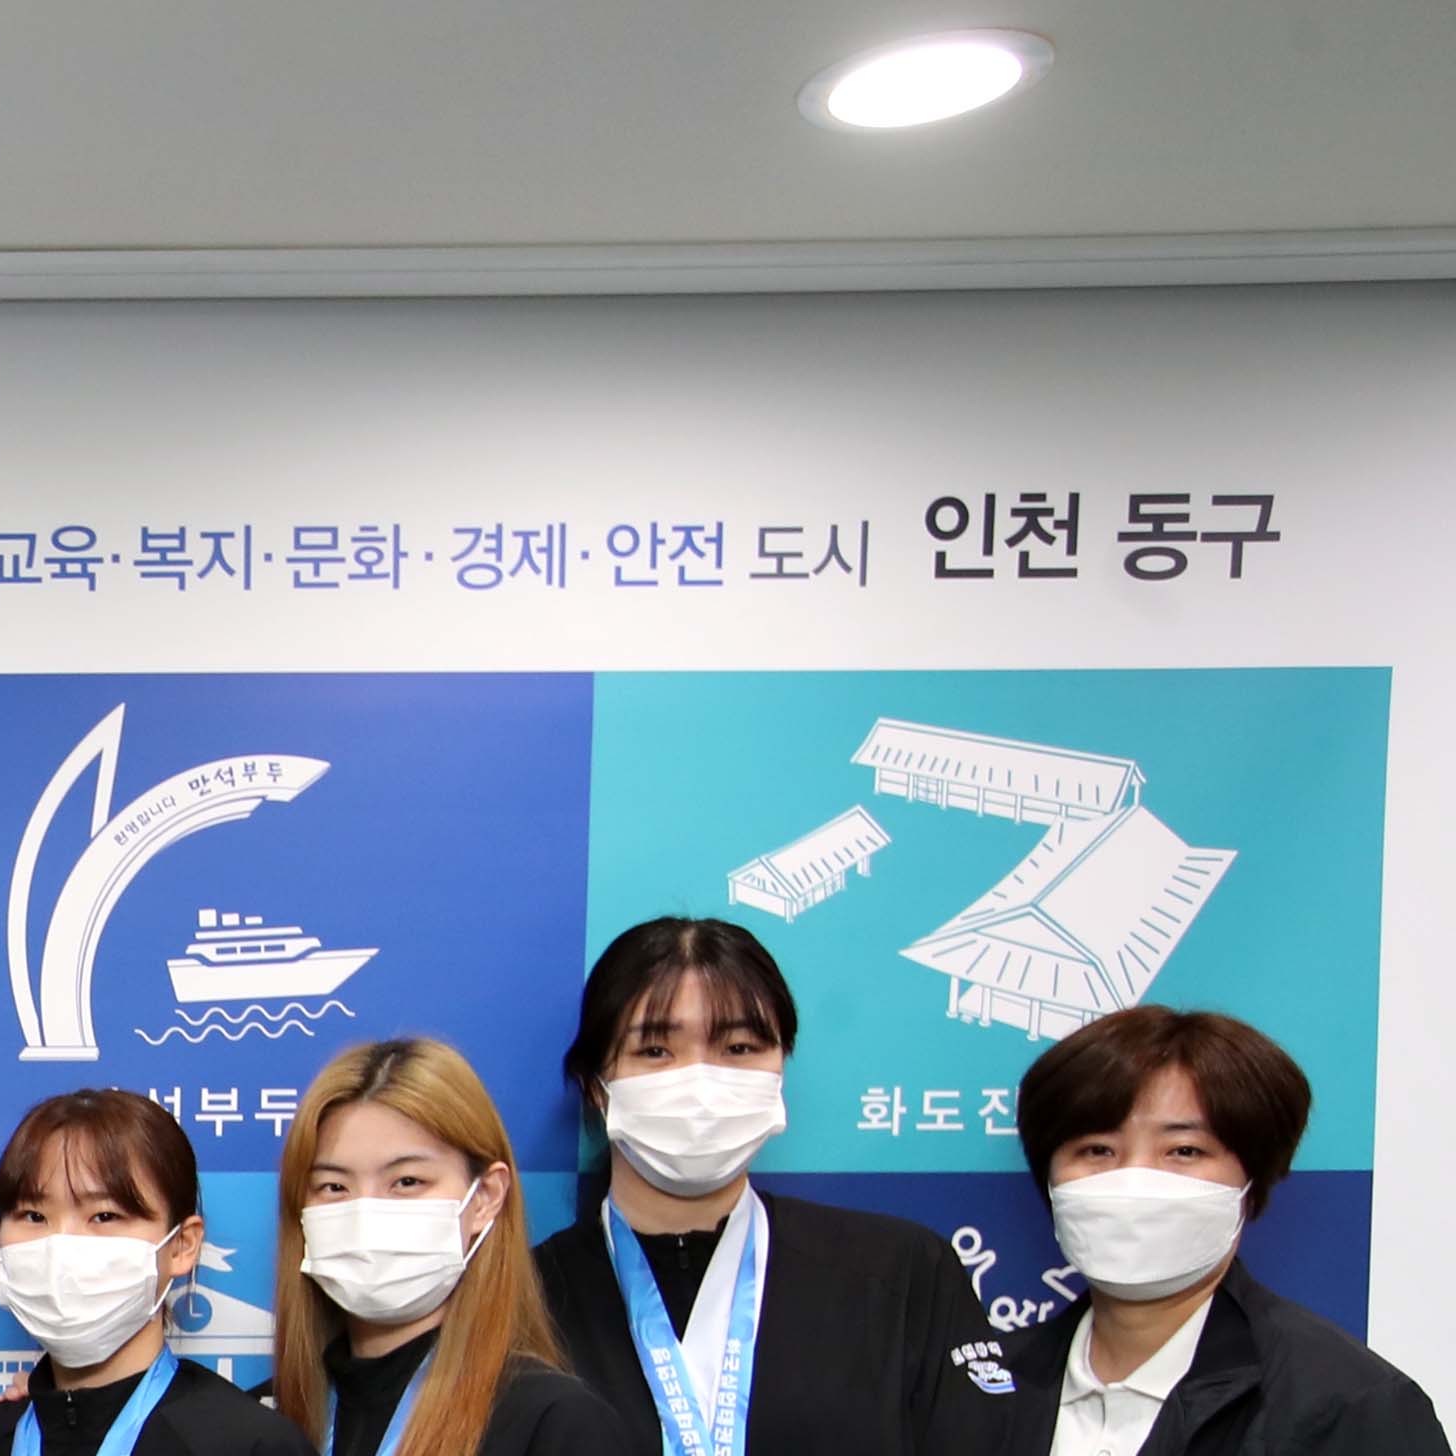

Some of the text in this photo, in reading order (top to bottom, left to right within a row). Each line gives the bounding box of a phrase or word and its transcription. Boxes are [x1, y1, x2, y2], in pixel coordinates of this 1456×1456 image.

[749, 519, 870, 588] 도시
[924, 491, 1082, 580] 인천
[1116, 492, 1282, 581] 동구
[187, 761, 284, 797] 만석부두
